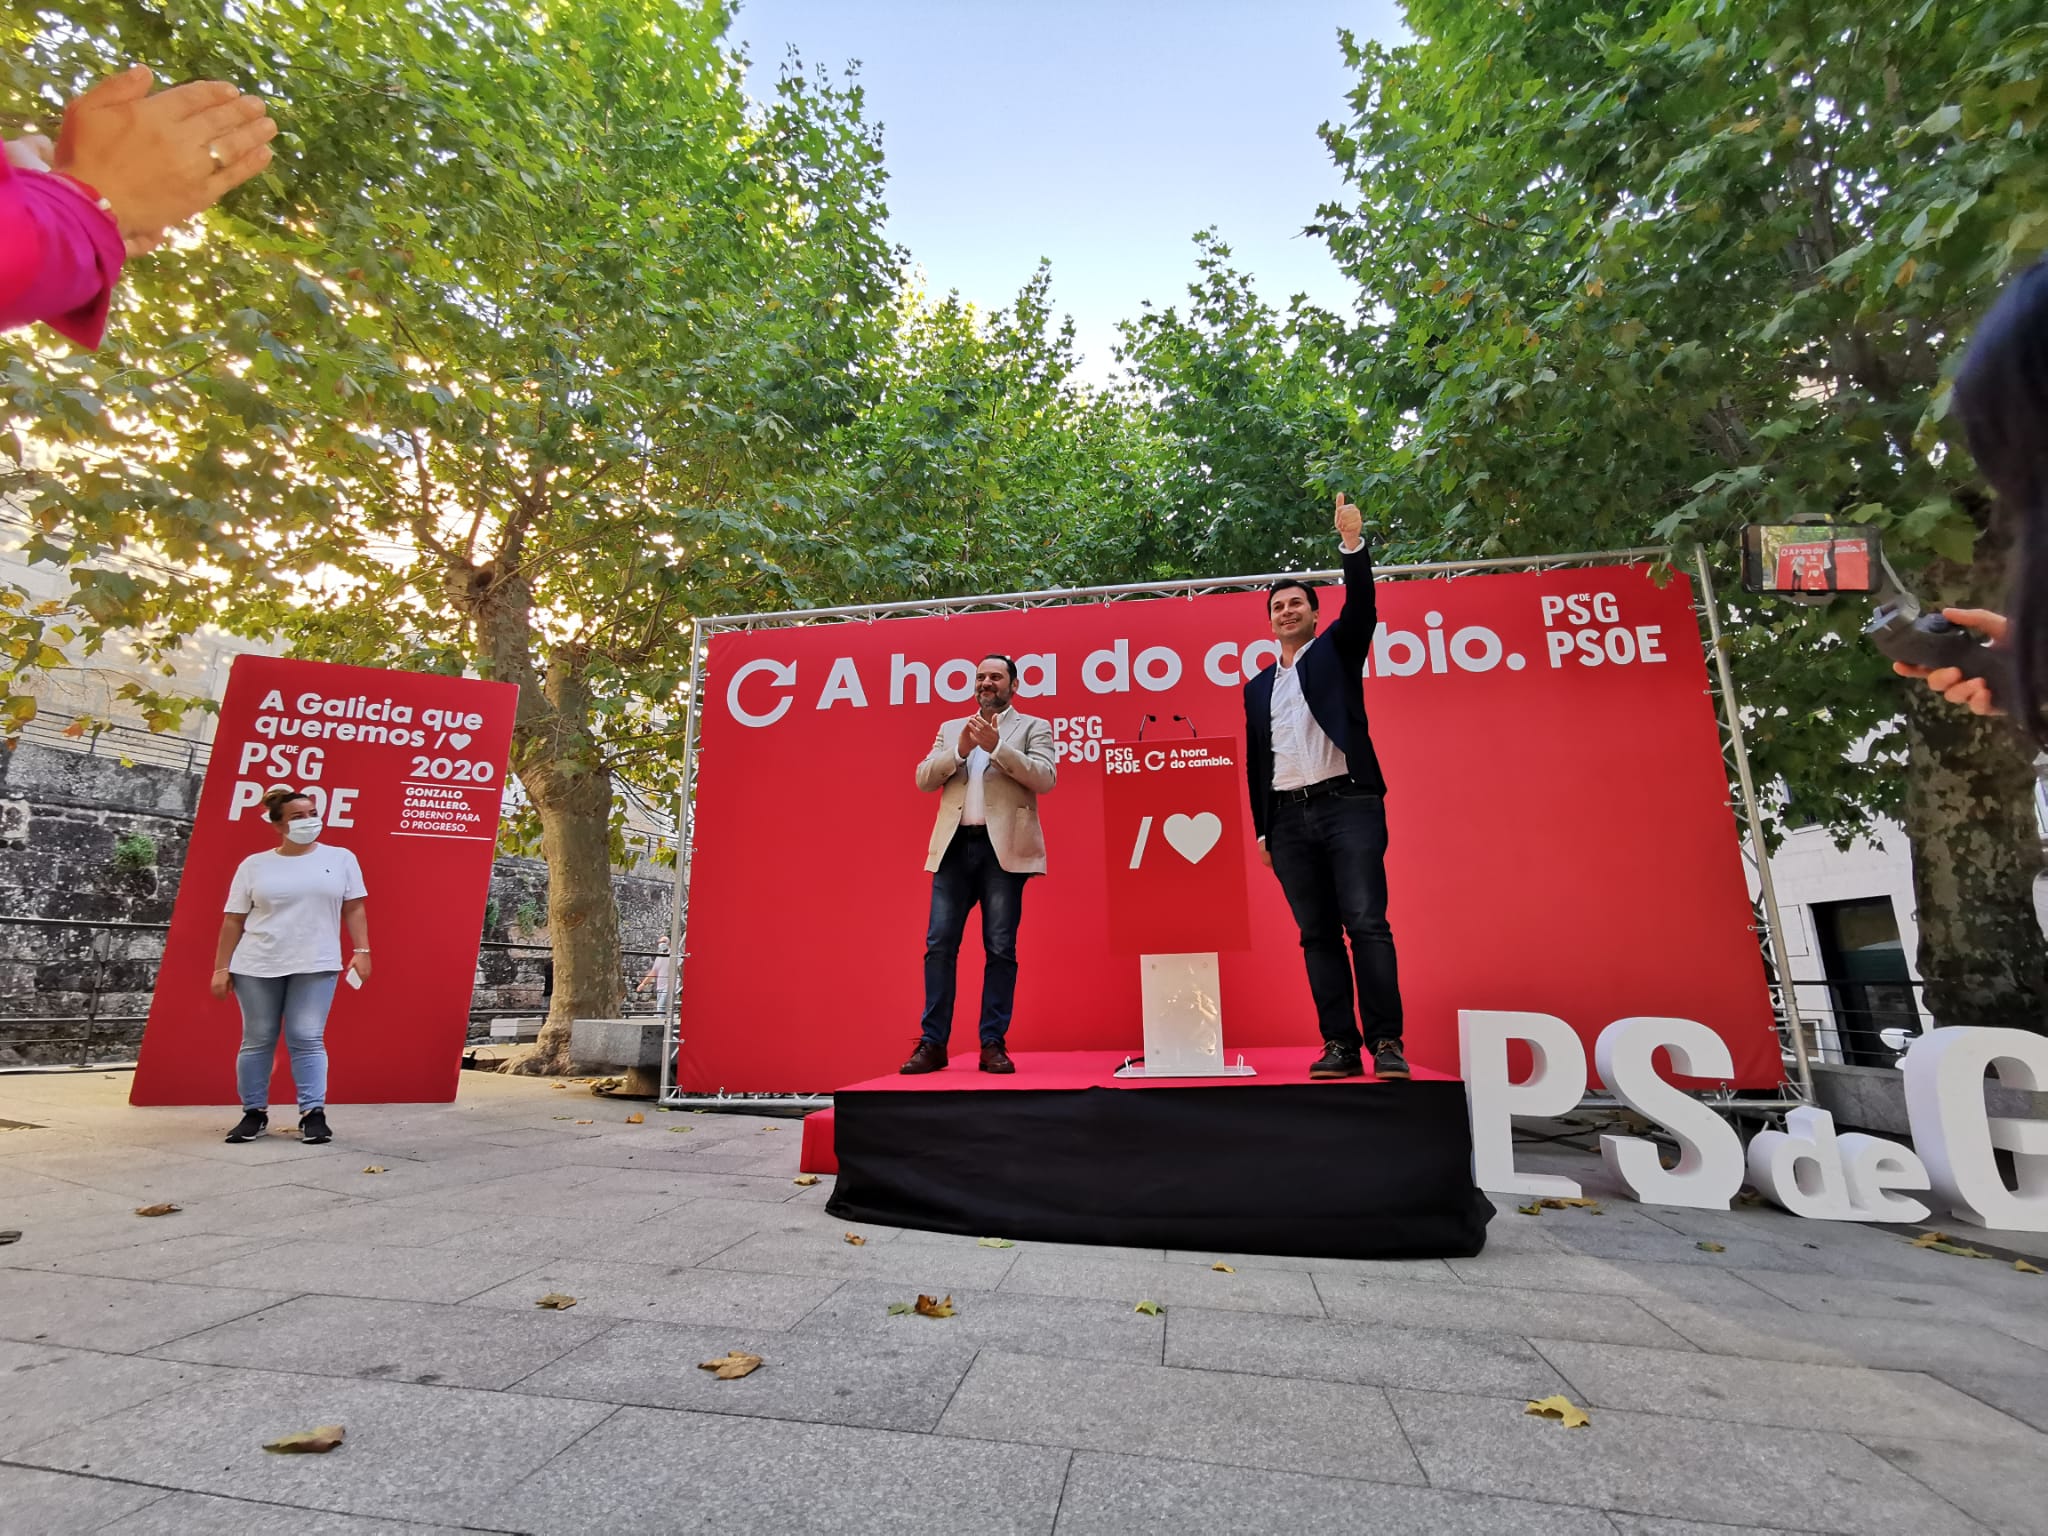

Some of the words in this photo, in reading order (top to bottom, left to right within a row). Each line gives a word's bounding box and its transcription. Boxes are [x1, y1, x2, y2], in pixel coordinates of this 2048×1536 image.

[1546, 625, 1667, 668] PSOE
[816, 657, 869, 710] A
[889, 653, 1057, 705] hoa
[1082, 639, 1183, 694] do
[1203, 610, 1526, 687] cabio.
[259, 690, 284, 712] A
[296, 692, 413, 724] Galicia
[422, 709, 483, 732] que
[255, 715, 426, 748] queremos
[1170, 749, 1179, 758] A
[1181, 748, 1208, 758] hora
[409, 755, 494, 782] 2020
[1106, 760, 1141, 775] PSOE
[1170, 759, 1186, 769] do
[1188, 756, 1234, 768] cambio.
[405, 787, 463, 799] GONZALO
[403, 797, 471, 811] CABALLERO.
[401, 808, 454, 821] GOBERNO
[455, 812, 481, 822] PARA
[400, 819, 410, 829] O
[411, 820, 469, 833] PROGRESO.
